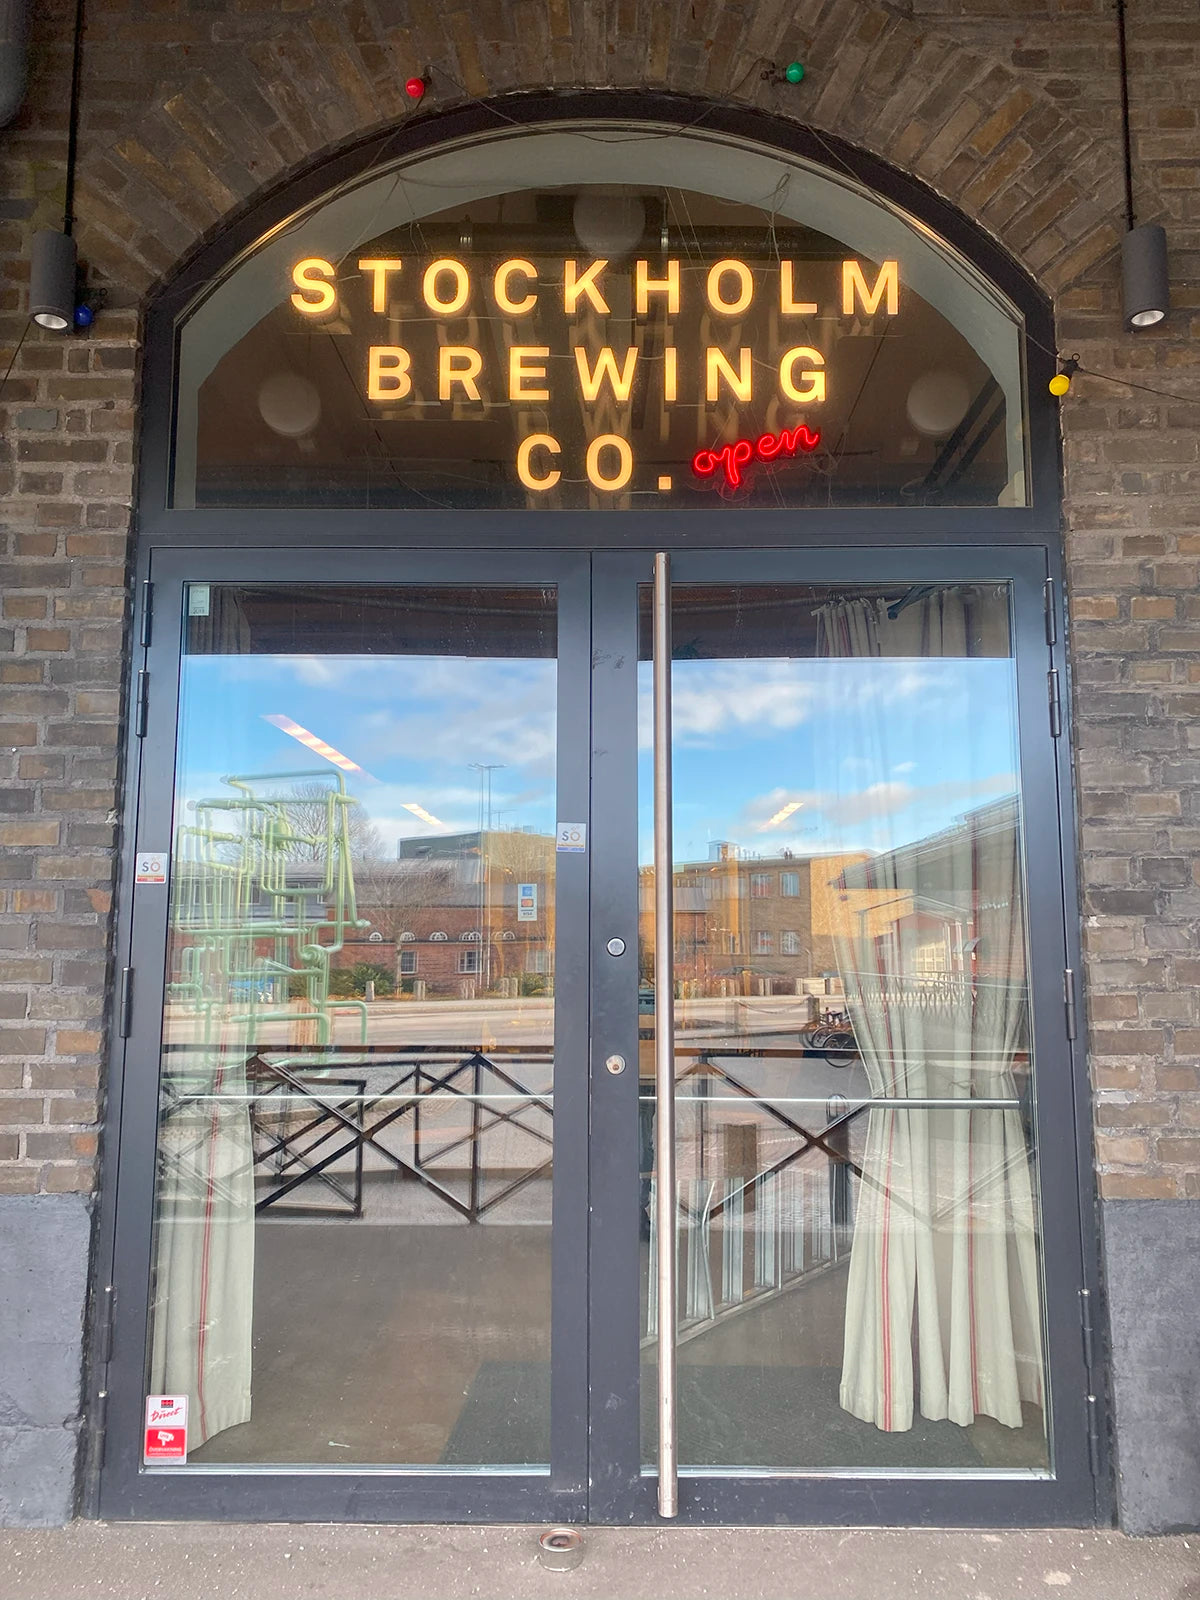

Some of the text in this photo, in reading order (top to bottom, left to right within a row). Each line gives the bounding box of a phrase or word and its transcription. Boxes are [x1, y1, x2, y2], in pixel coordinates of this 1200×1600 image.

[290, 258, 899, 315] STOCKHOLM
[367, 346, 826, 402] BREWING
[517, 434, 672, 490] CO.
[692, 424, 819, 489] open
[151, 1407, 182, 1422] Direct
